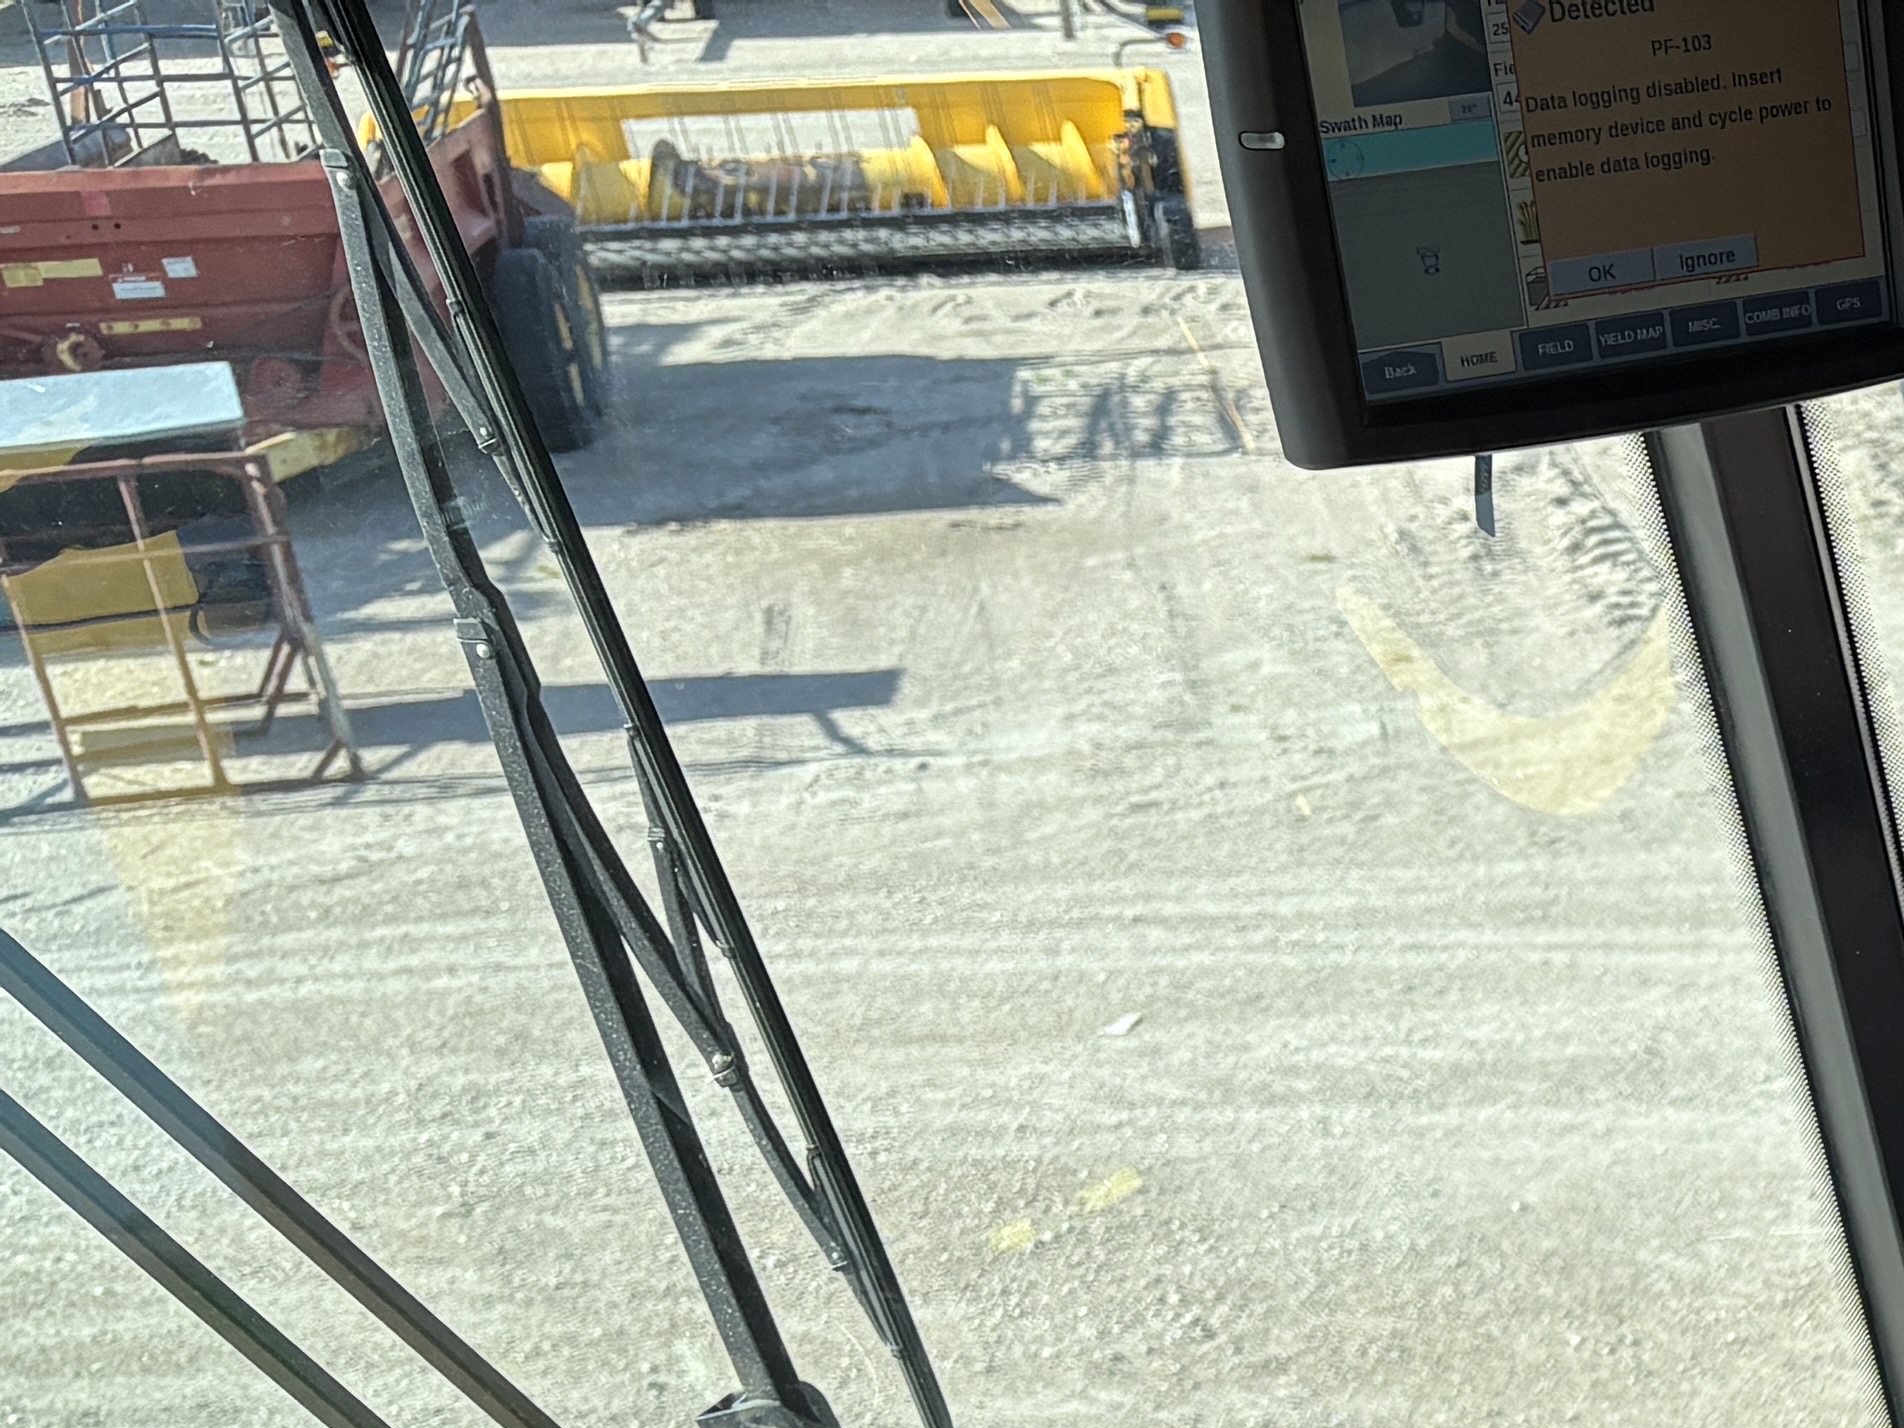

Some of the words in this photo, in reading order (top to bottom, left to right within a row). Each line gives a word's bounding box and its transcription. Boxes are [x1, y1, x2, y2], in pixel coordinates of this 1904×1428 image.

[1651, 35, 1712, 56] PF-103
[1525, 95, 1567, 113] Data
[1573, 85, 1640, 109] logging
[1646, 74, 1726, 98] disabled.
[1732, 67, 1782, 88] Insert
[1320, 114, 1368, 134] Swath
[1372, 113, 1402, 129] Map
[1531, 126, 1602, 149] memory
[1608, 117, 1665, 138] device
[1671, 110, 1702, 131] and
[1708, 106, 1753, 128] cycle
[1759, 101, 1809, 124] power
[1815, 96, 1832, 112] to
[1536, 161, 1594, 183] enable
[1600, 154, 1640, 175] data
[1645, 147, 1715, 173] logging.
[1680, 248, 1735, 272] Ignore
[1588, 265, 1615, 281] OK
[1746, 308, 1780, 324] COMB
[1783, 304, 1810, 319] INFO
[1837, 296, 1860, 311] GPS
[1599, 329, 1635, 347] YIELD
[1637, 326, 1663, 340] MAP
[1538, 341, 1574, 355] FIELD
[1461, 352, 1497, 367] HOME
[1385, 364, 1416, 379] Back
